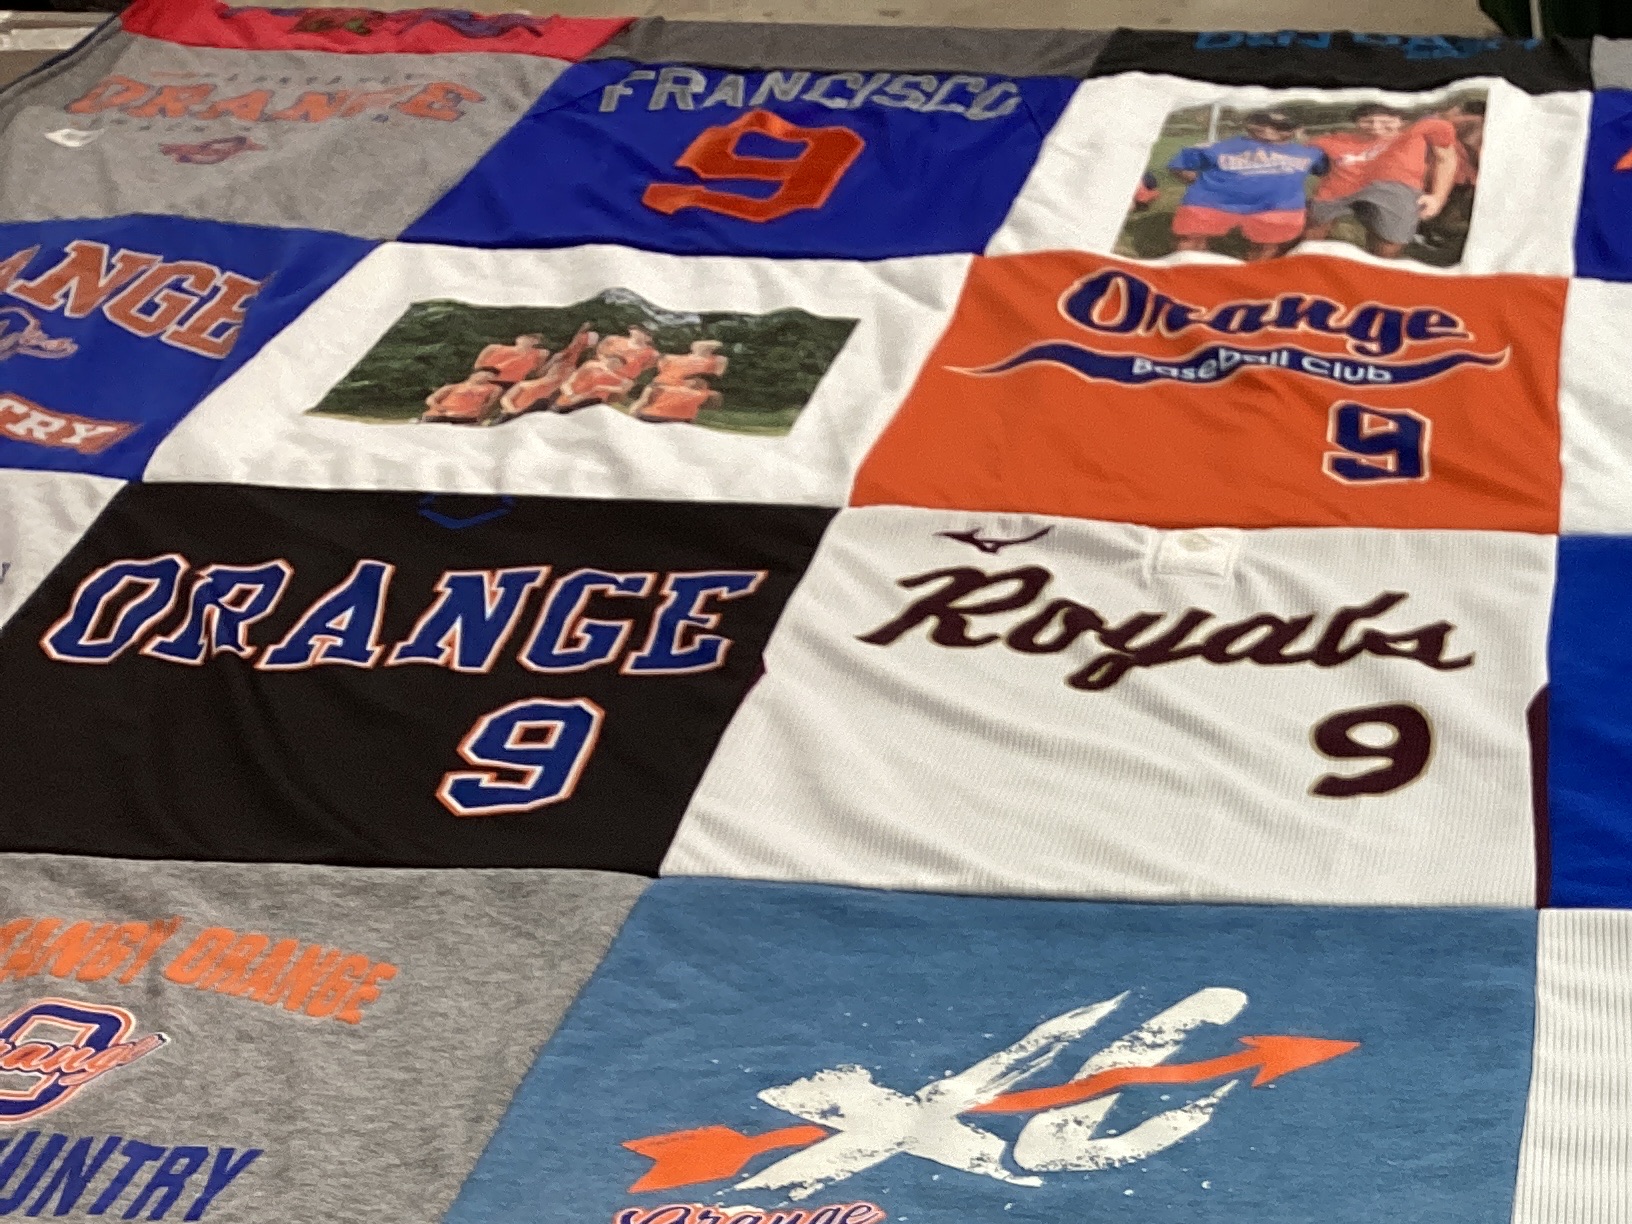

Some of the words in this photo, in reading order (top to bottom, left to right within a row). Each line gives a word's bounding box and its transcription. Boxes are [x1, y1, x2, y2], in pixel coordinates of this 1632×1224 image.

[599, 67, 1022, 121] FRANCISCO
[642, 109, 866, 223] 9
[1058, 267, 1475, 359] Orange
[1132, 347, 1290, 382] Baseball
[1301, 355, 1394, 382] Club
[1322, 400, 1432, 486] 9
[40, 554, 768, 675] ORANGE
[436, 697, 605, 817] 9
[1307, 701, 1434, 799] 9
[164, 927, 398, 1025] ORANGE
